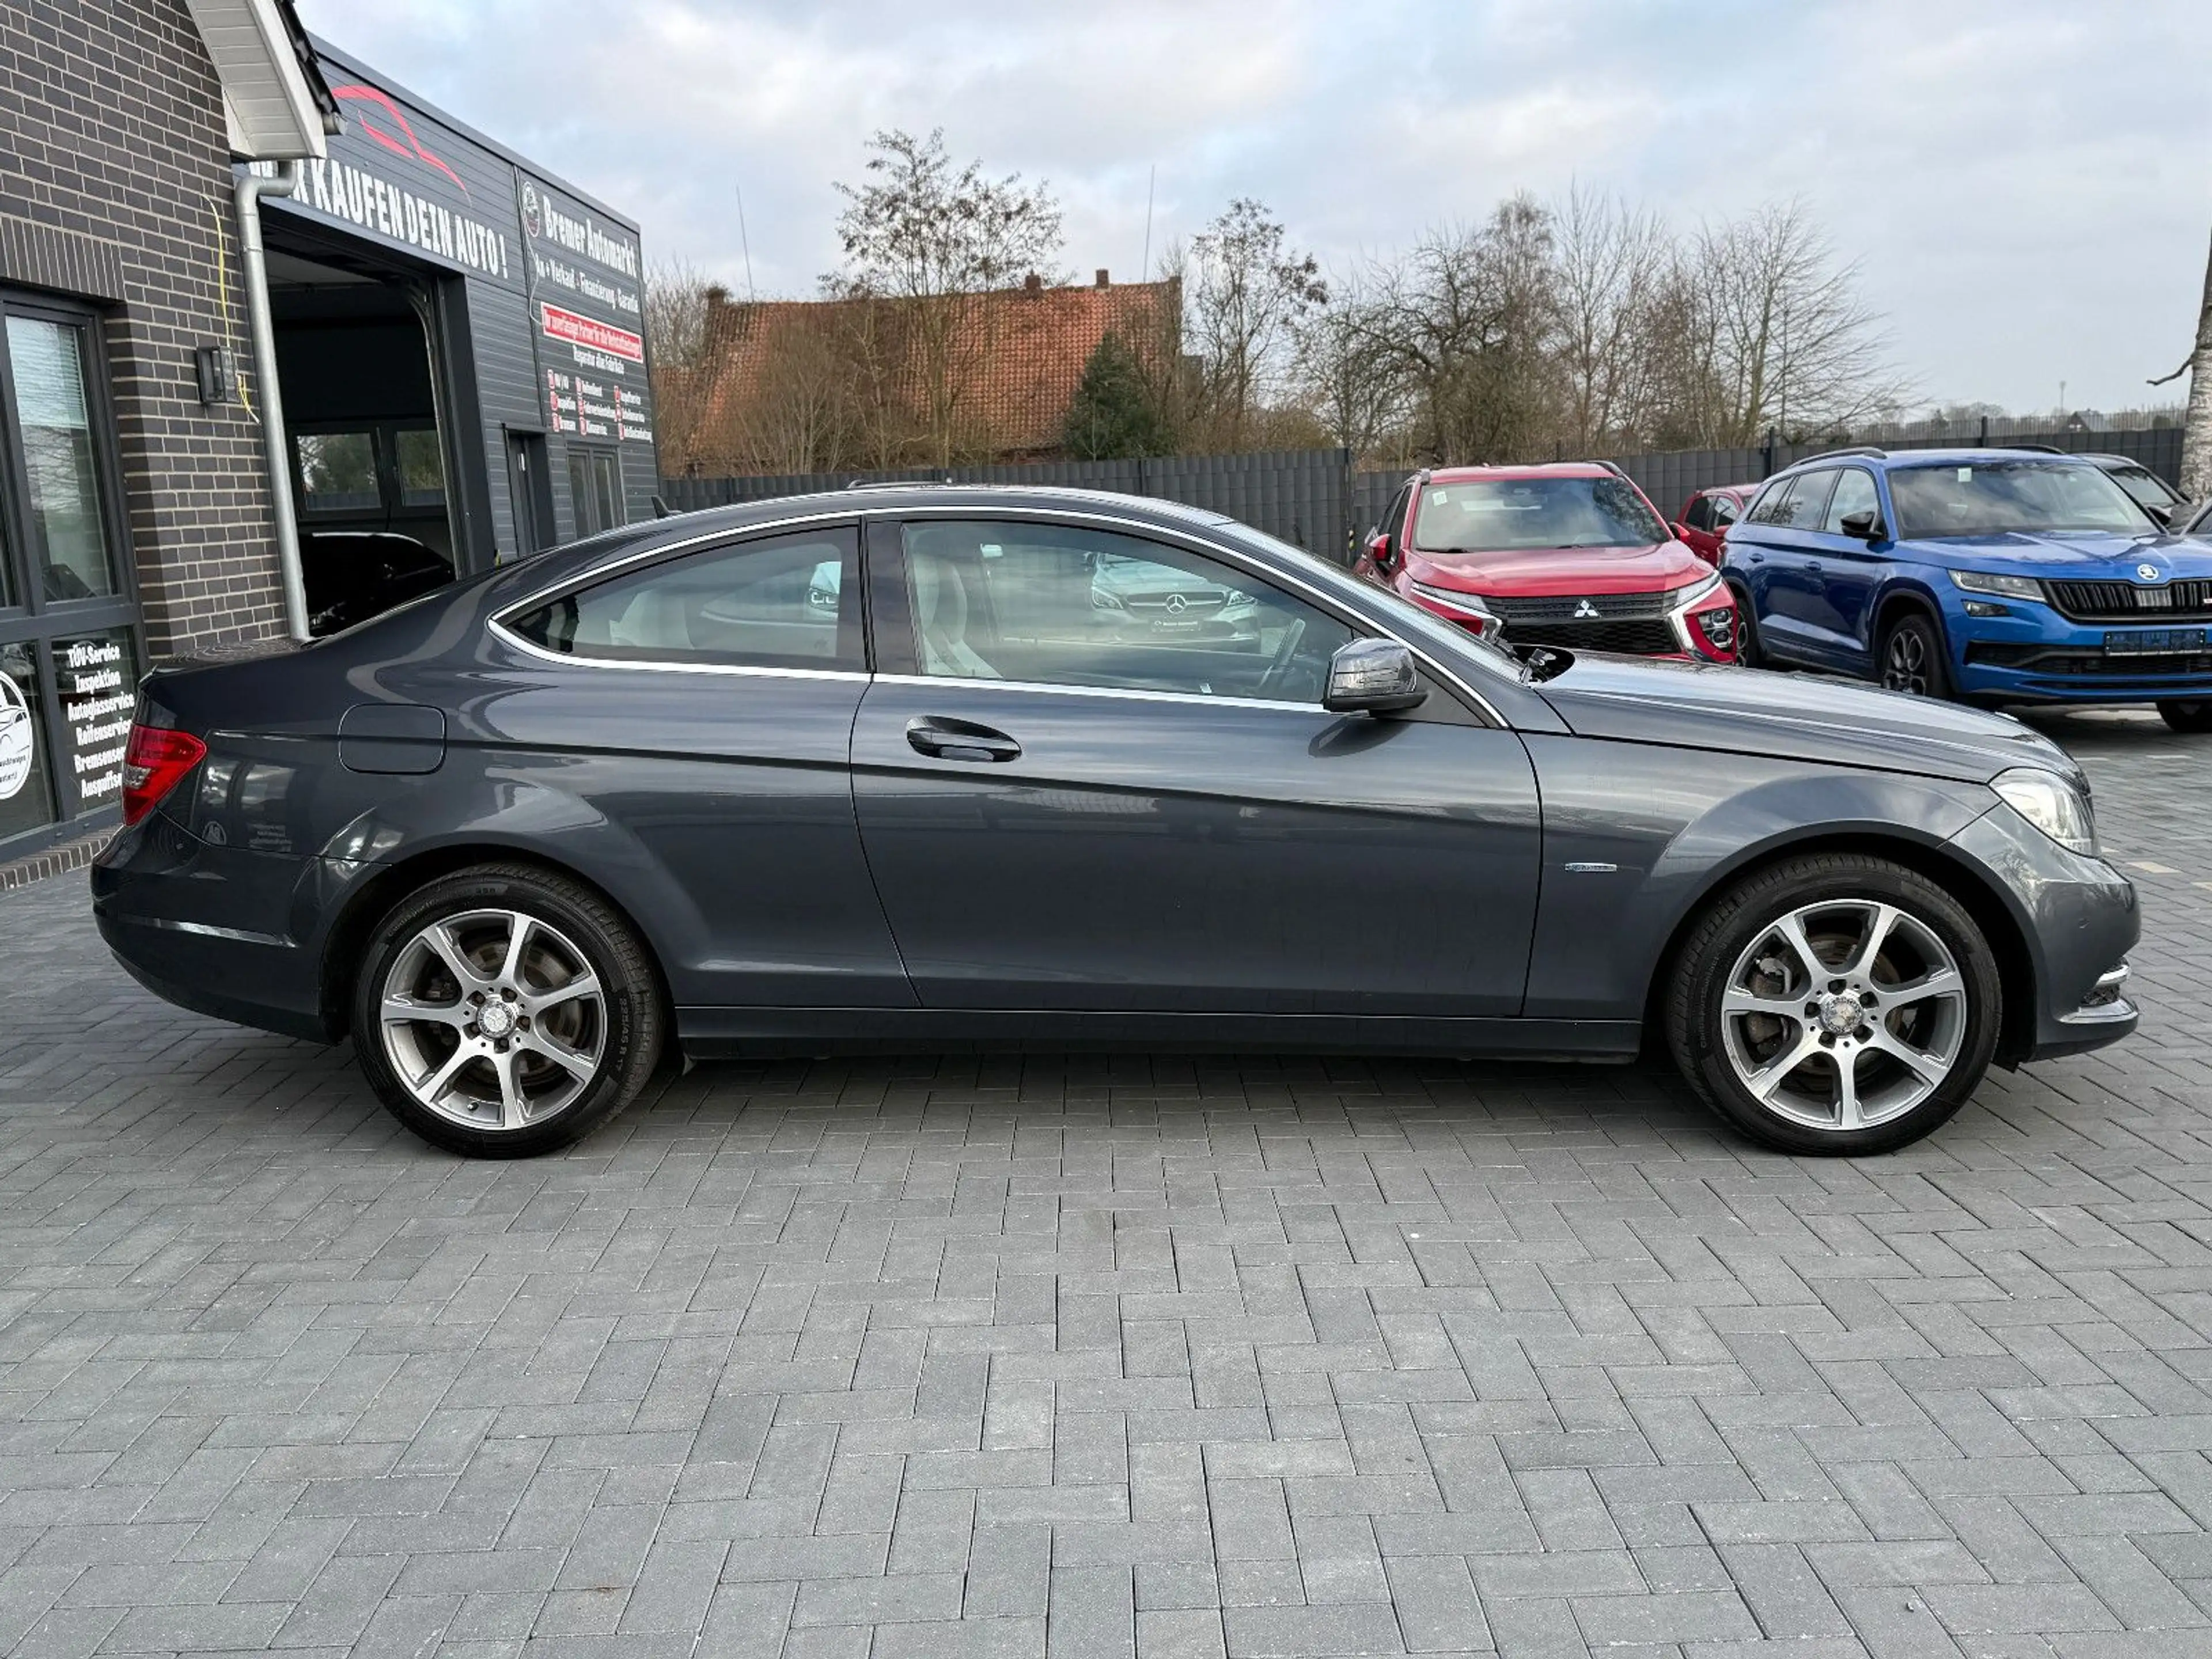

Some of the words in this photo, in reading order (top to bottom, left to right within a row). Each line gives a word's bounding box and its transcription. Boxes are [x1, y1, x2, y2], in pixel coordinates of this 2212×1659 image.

[248, 158, 309, 204] WR
[310, 158, 404, 240] KAUFEN
[404, 193, 454, 259] DEIN
[543, 195, 585, 253] Bremer
[586, 218, 637, 278] Automarkt
[67, 642, 120, 668] TÜV-Service
[74, 668, 121, 695] Inspektion
[67, 691, 135, 722] Autoglasservice
